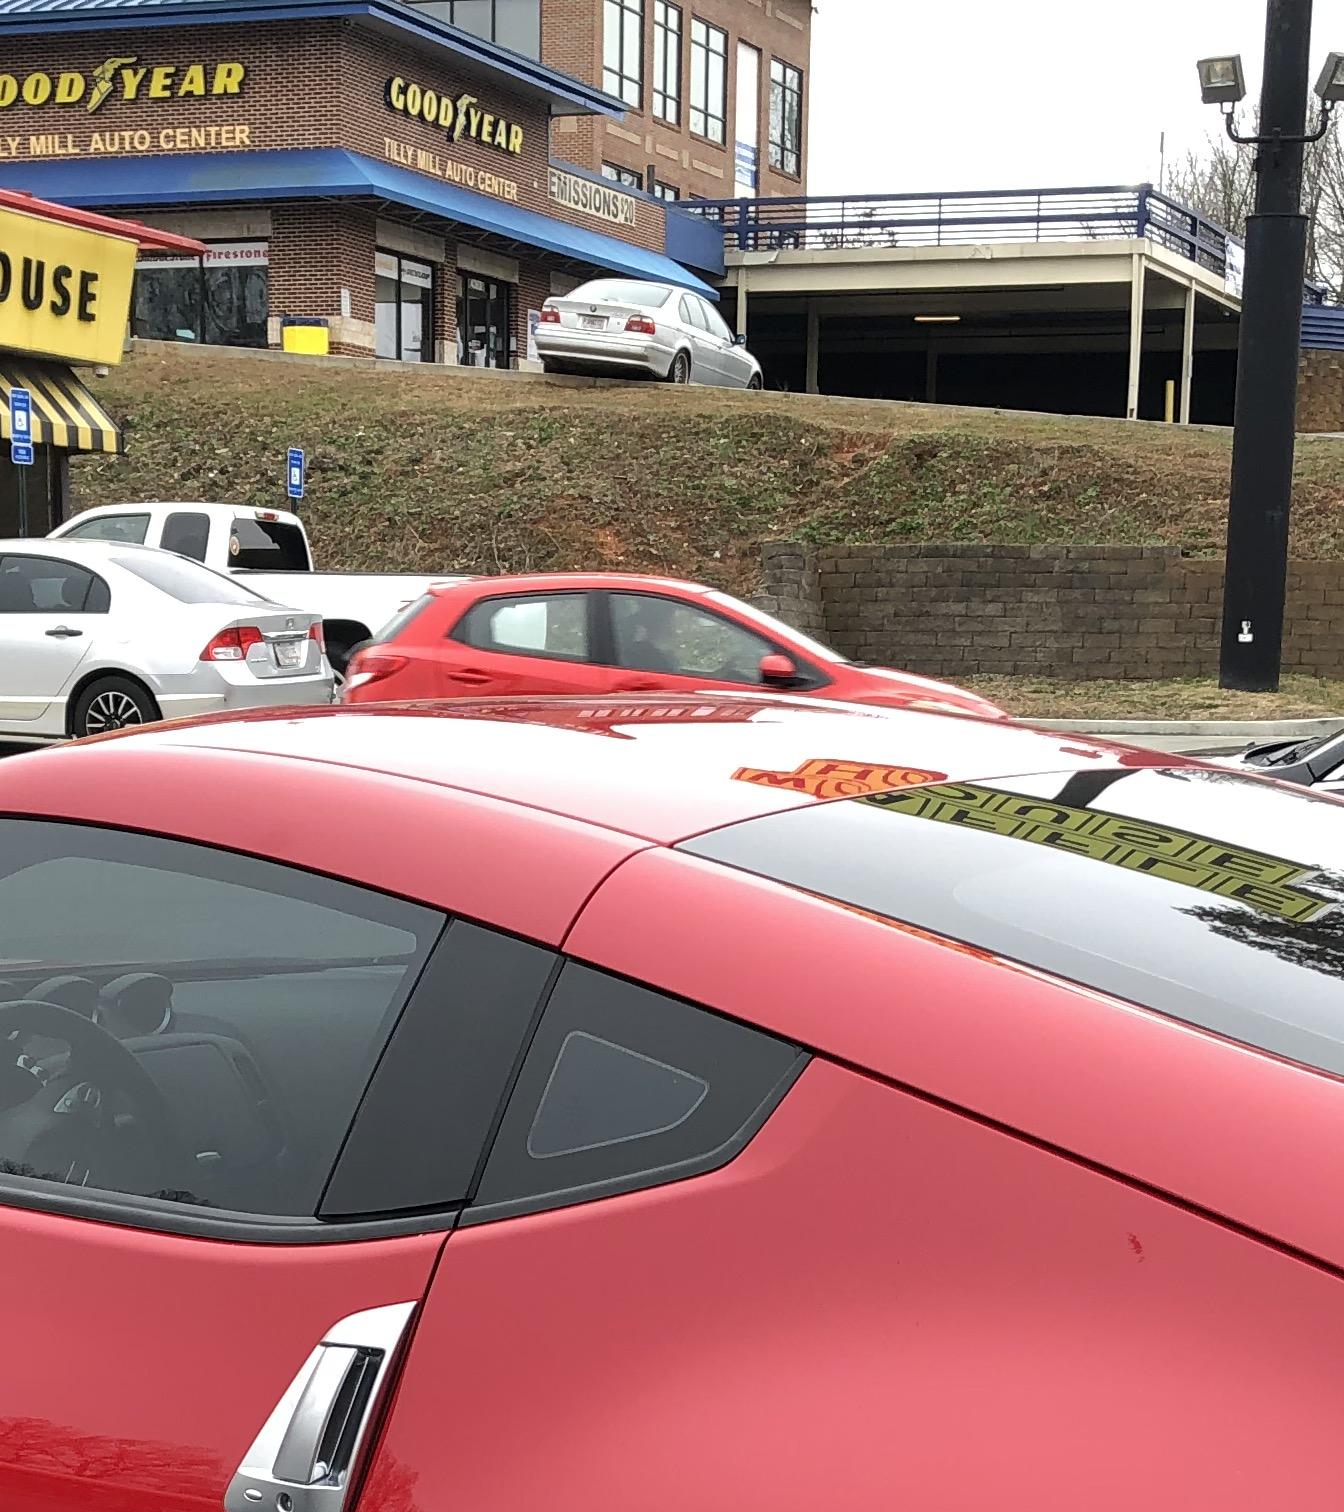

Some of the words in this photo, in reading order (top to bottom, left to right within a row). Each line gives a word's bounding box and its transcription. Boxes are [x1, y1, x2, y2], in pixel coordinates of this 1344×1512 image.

[29, 134, 81, 155] MILL
[89, 129, 151, 152] AUTO
[159, 125, 252, 150] CENTER
[389, 76, 524, 155] GOODYEAR
[383, 137, 413, 167] TILLY
[417, 149, 443, 177] MILL
[445, 161, 475, 187] AUTO
[477, 170, 519, 201] CENTER
[549, 168, 620, 220] EMISSIONS
[620, 195, 635, 225] $20
[205, 248, 270, 263] Firestone
